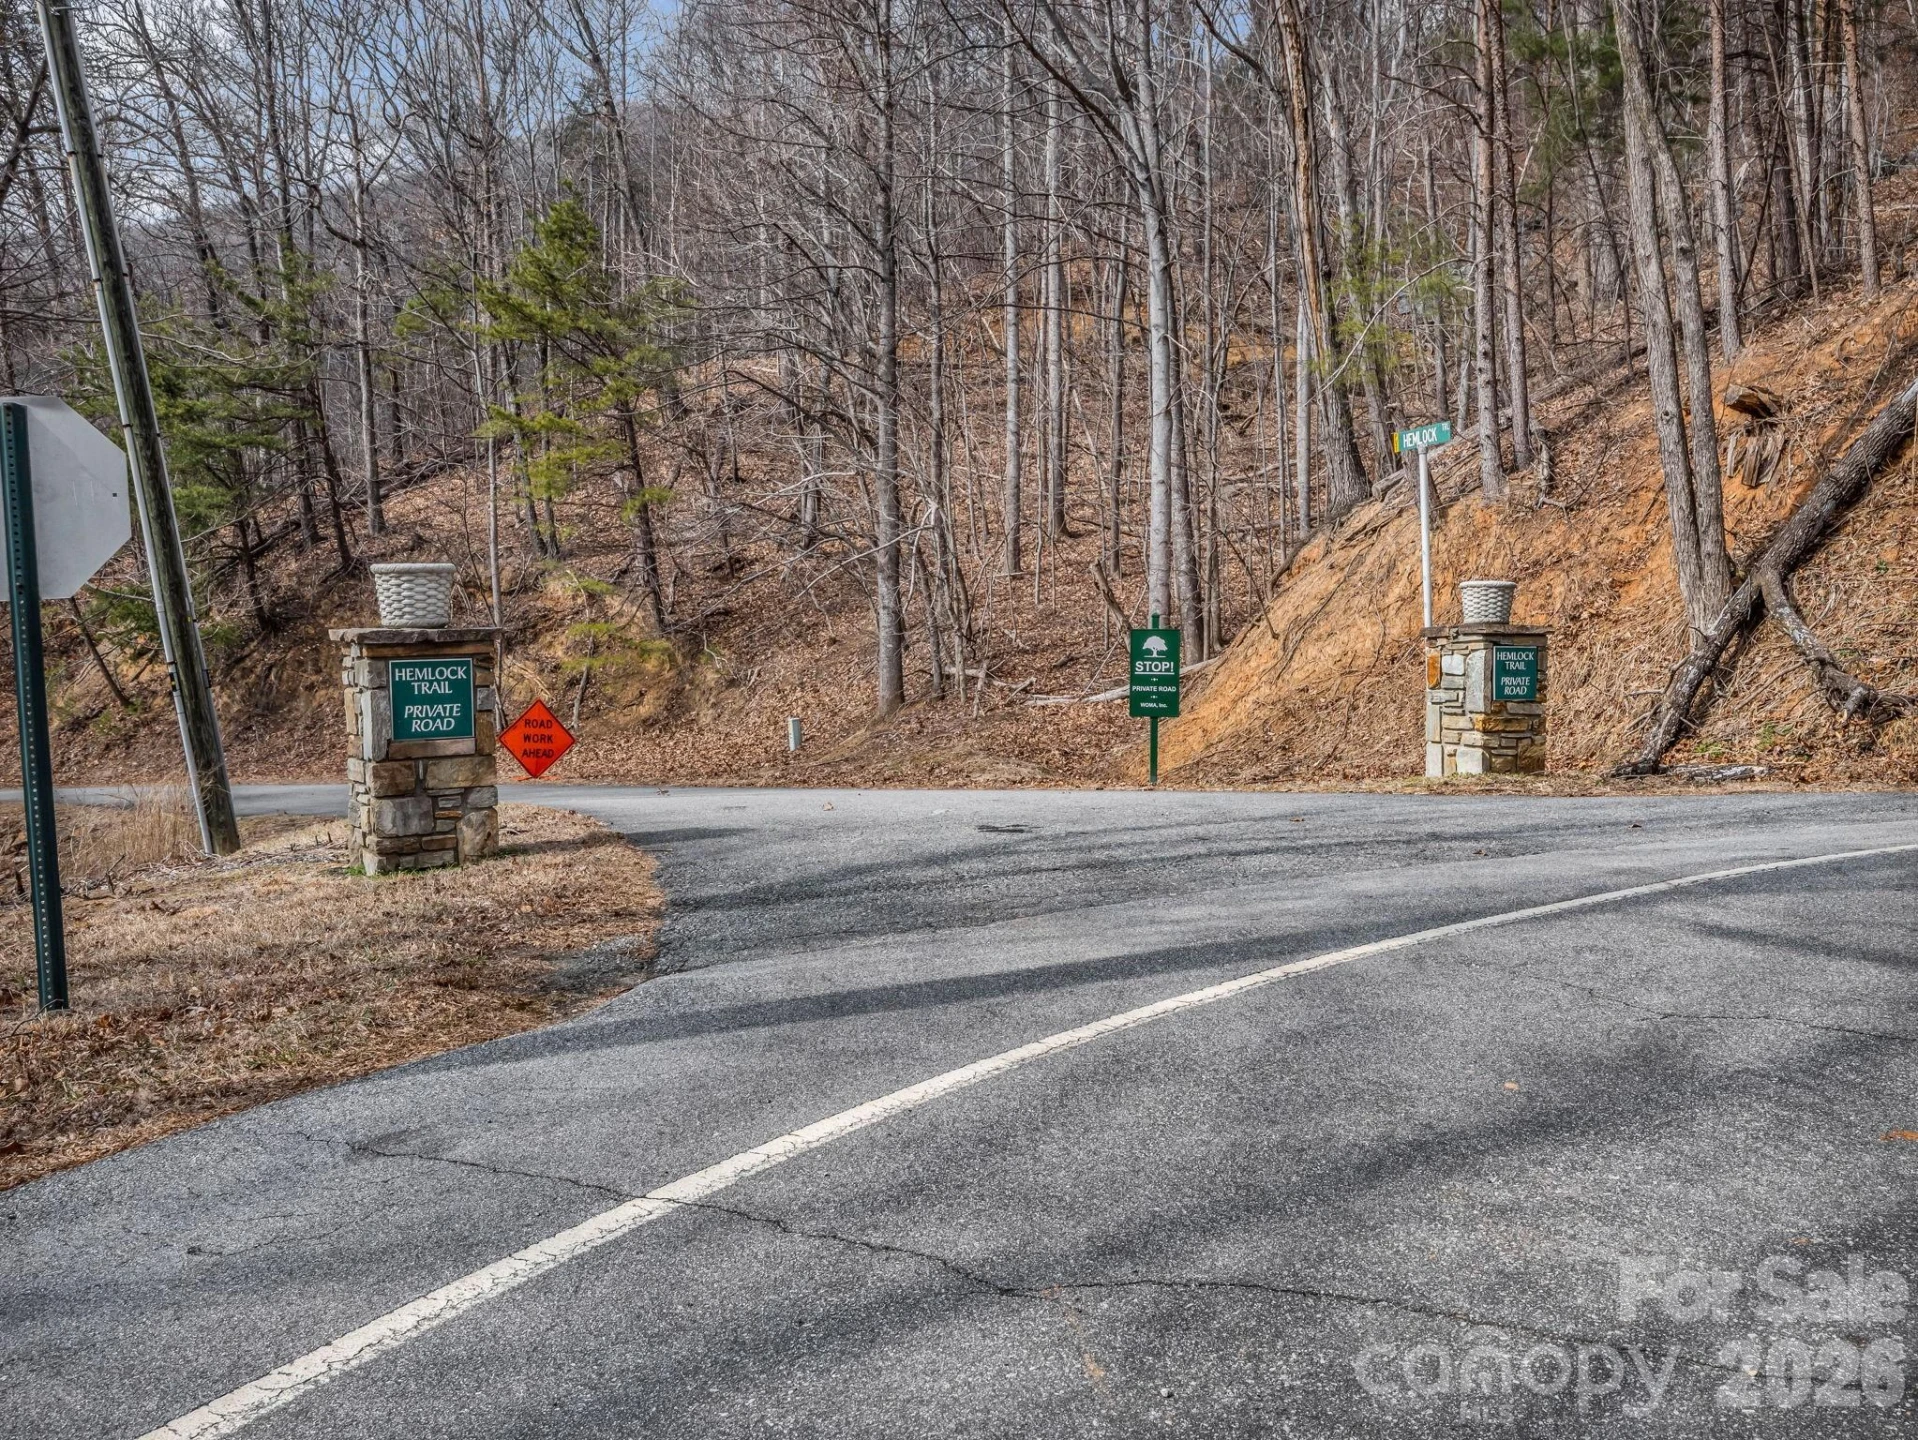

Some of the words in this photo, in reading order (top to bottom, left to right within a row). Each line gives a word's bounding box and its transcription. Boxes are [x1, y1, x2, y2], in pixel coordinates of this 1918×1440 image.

[1402, 427, 1438, 449] HEMLOCK
[1496, 651, 1535, 661] HEMLOCK
[1135, 661, 1174, 672] STOP!
[1504, 661, 1526, 670] TRAIL
[394, 666, 467, 681] HEMLOCK
[1500, 676, 1531, 686] PRIVATE
[411, 681, 453, 695] TRAIL
[1503, 685, 1527, 695] ROAD
[404, 703, 461, 718] PRIVATE
[411, 718, 455, 732] ROAD
[524, 719, 553, 729] ROAD
[523, 734, 554, 744] WORK
[522, 749, 554, 758] AHEAD
